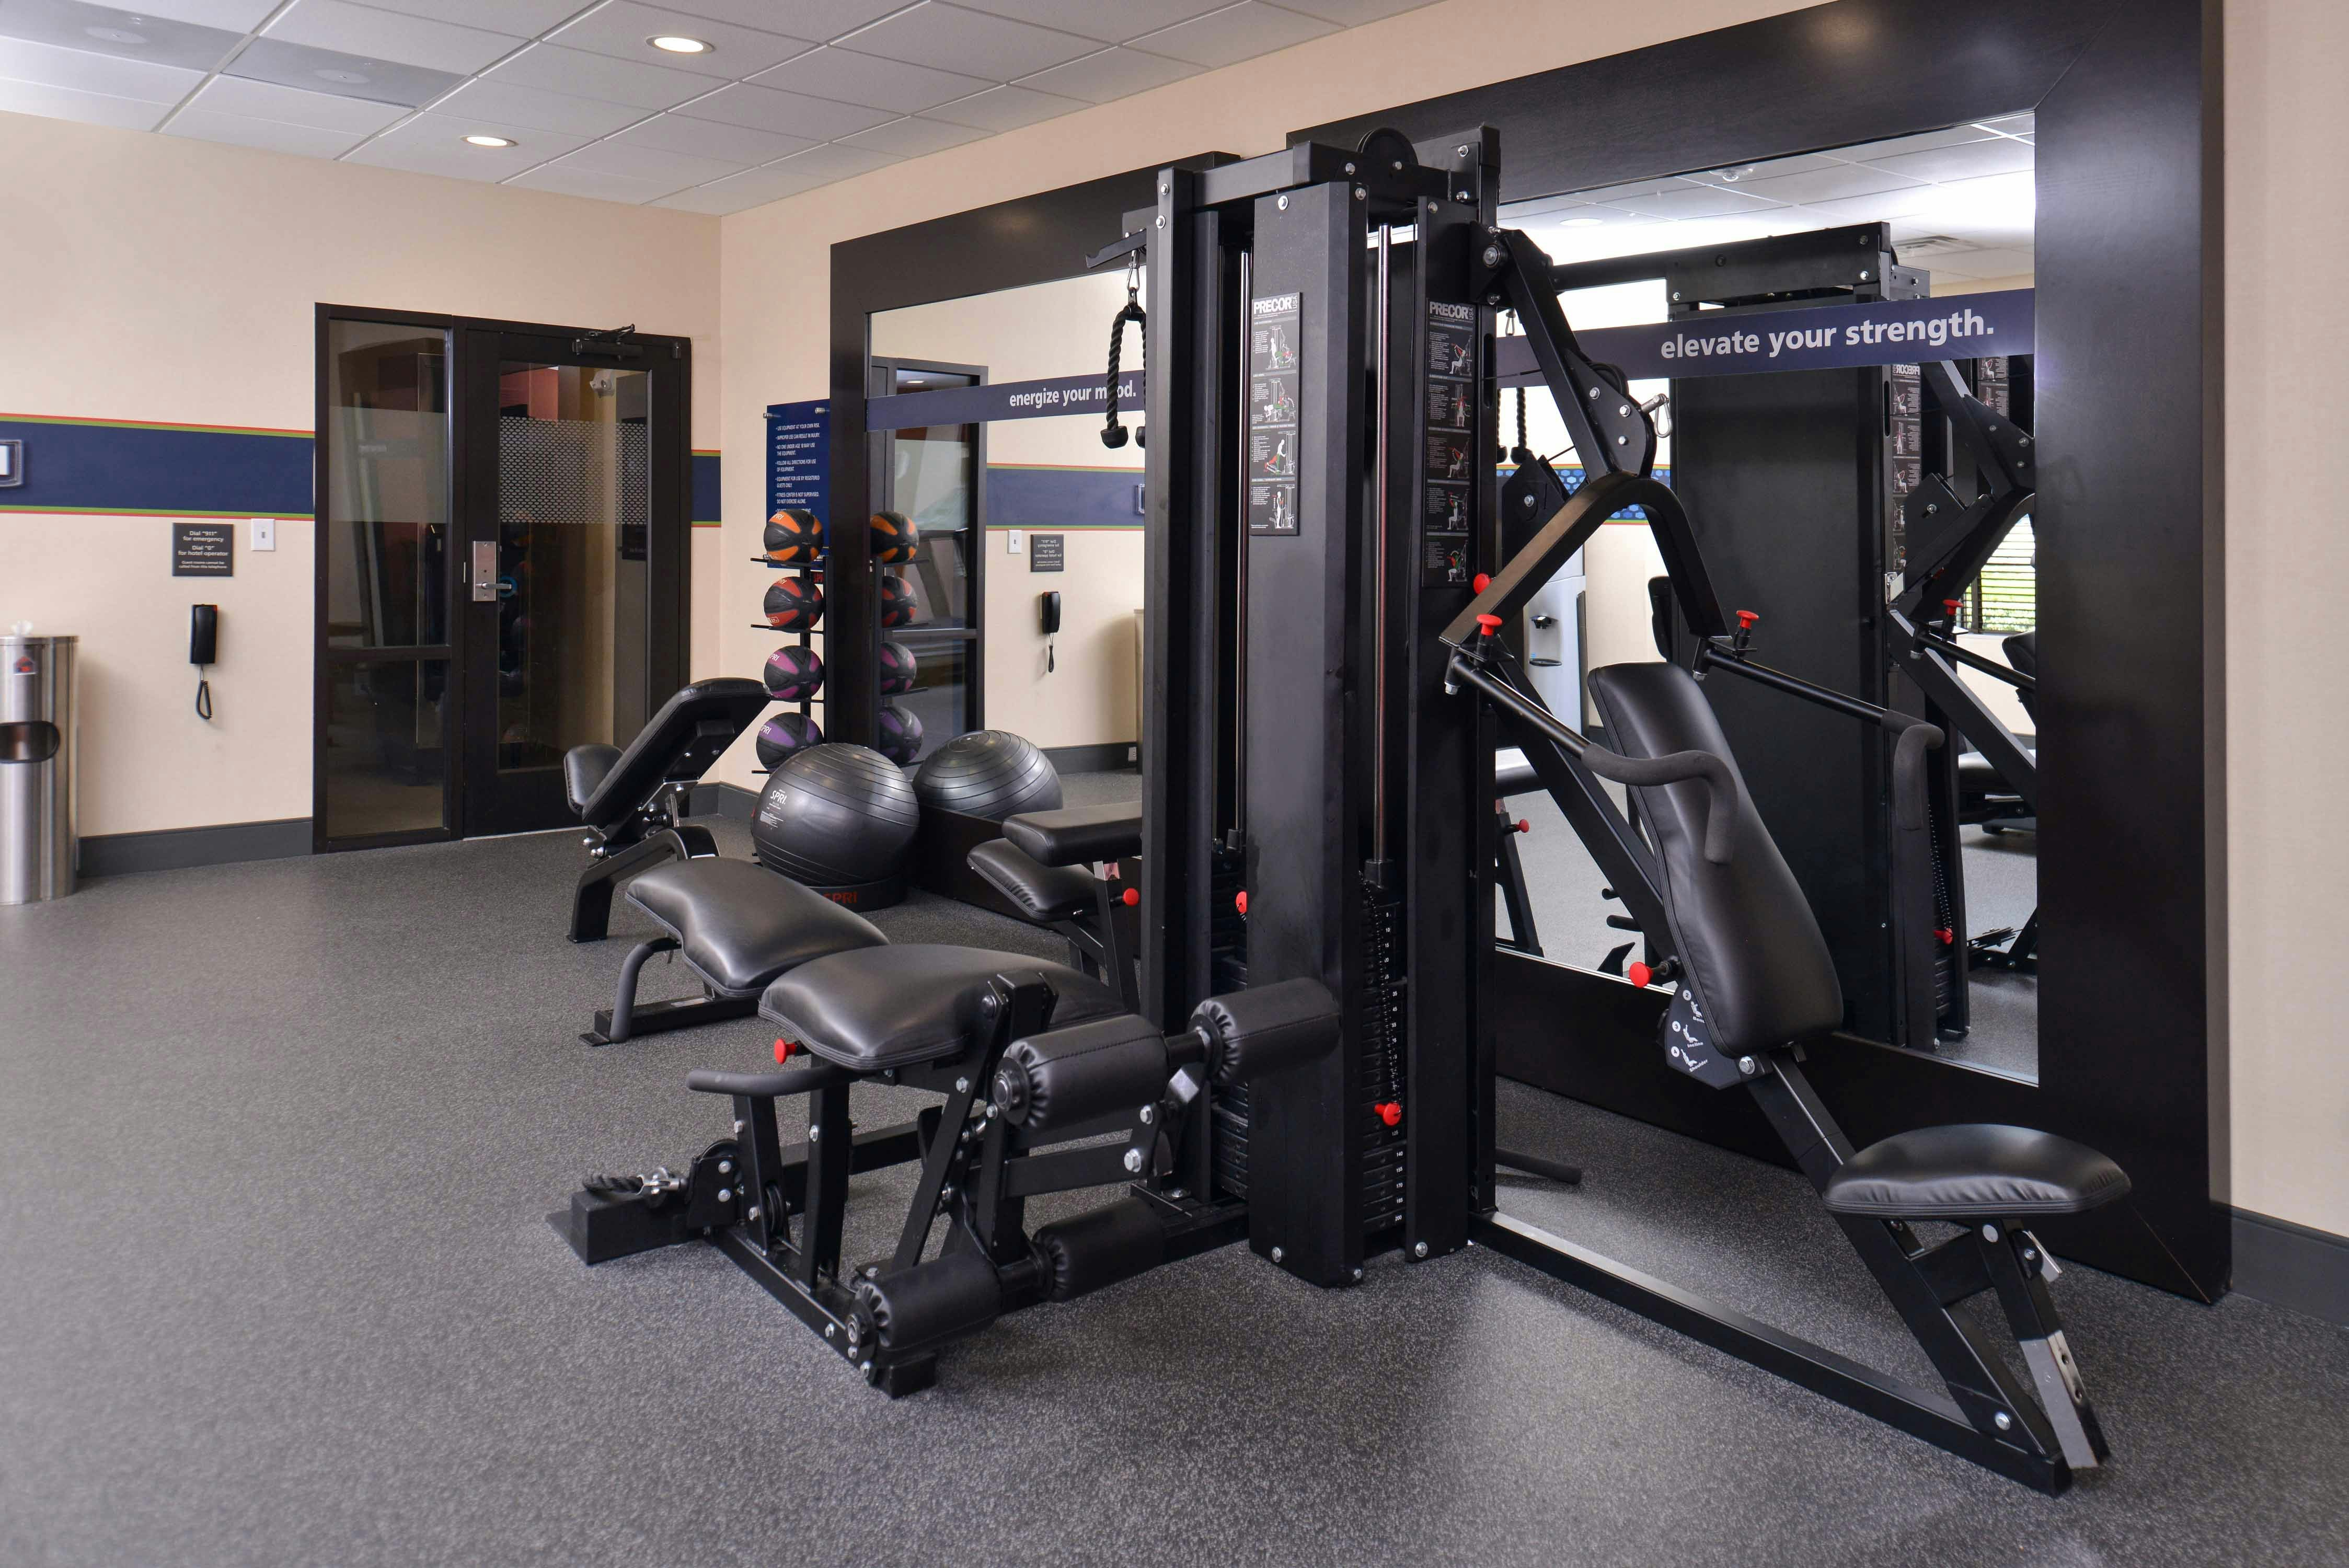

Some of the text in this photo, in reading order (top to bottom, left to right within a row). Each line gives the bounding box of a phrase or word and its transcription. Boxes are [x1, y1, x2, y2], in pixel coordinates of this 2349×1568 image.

[1254, 297, 1292, 314] PRECOR
[1430, 302, 1468, 319] PRECOR
[1661, 308, 1994, 359] elevate your strength.
[1009, 380, 1136, 409] energize your mod.
[1689, 1059, 1708, 1073] Shoulder
